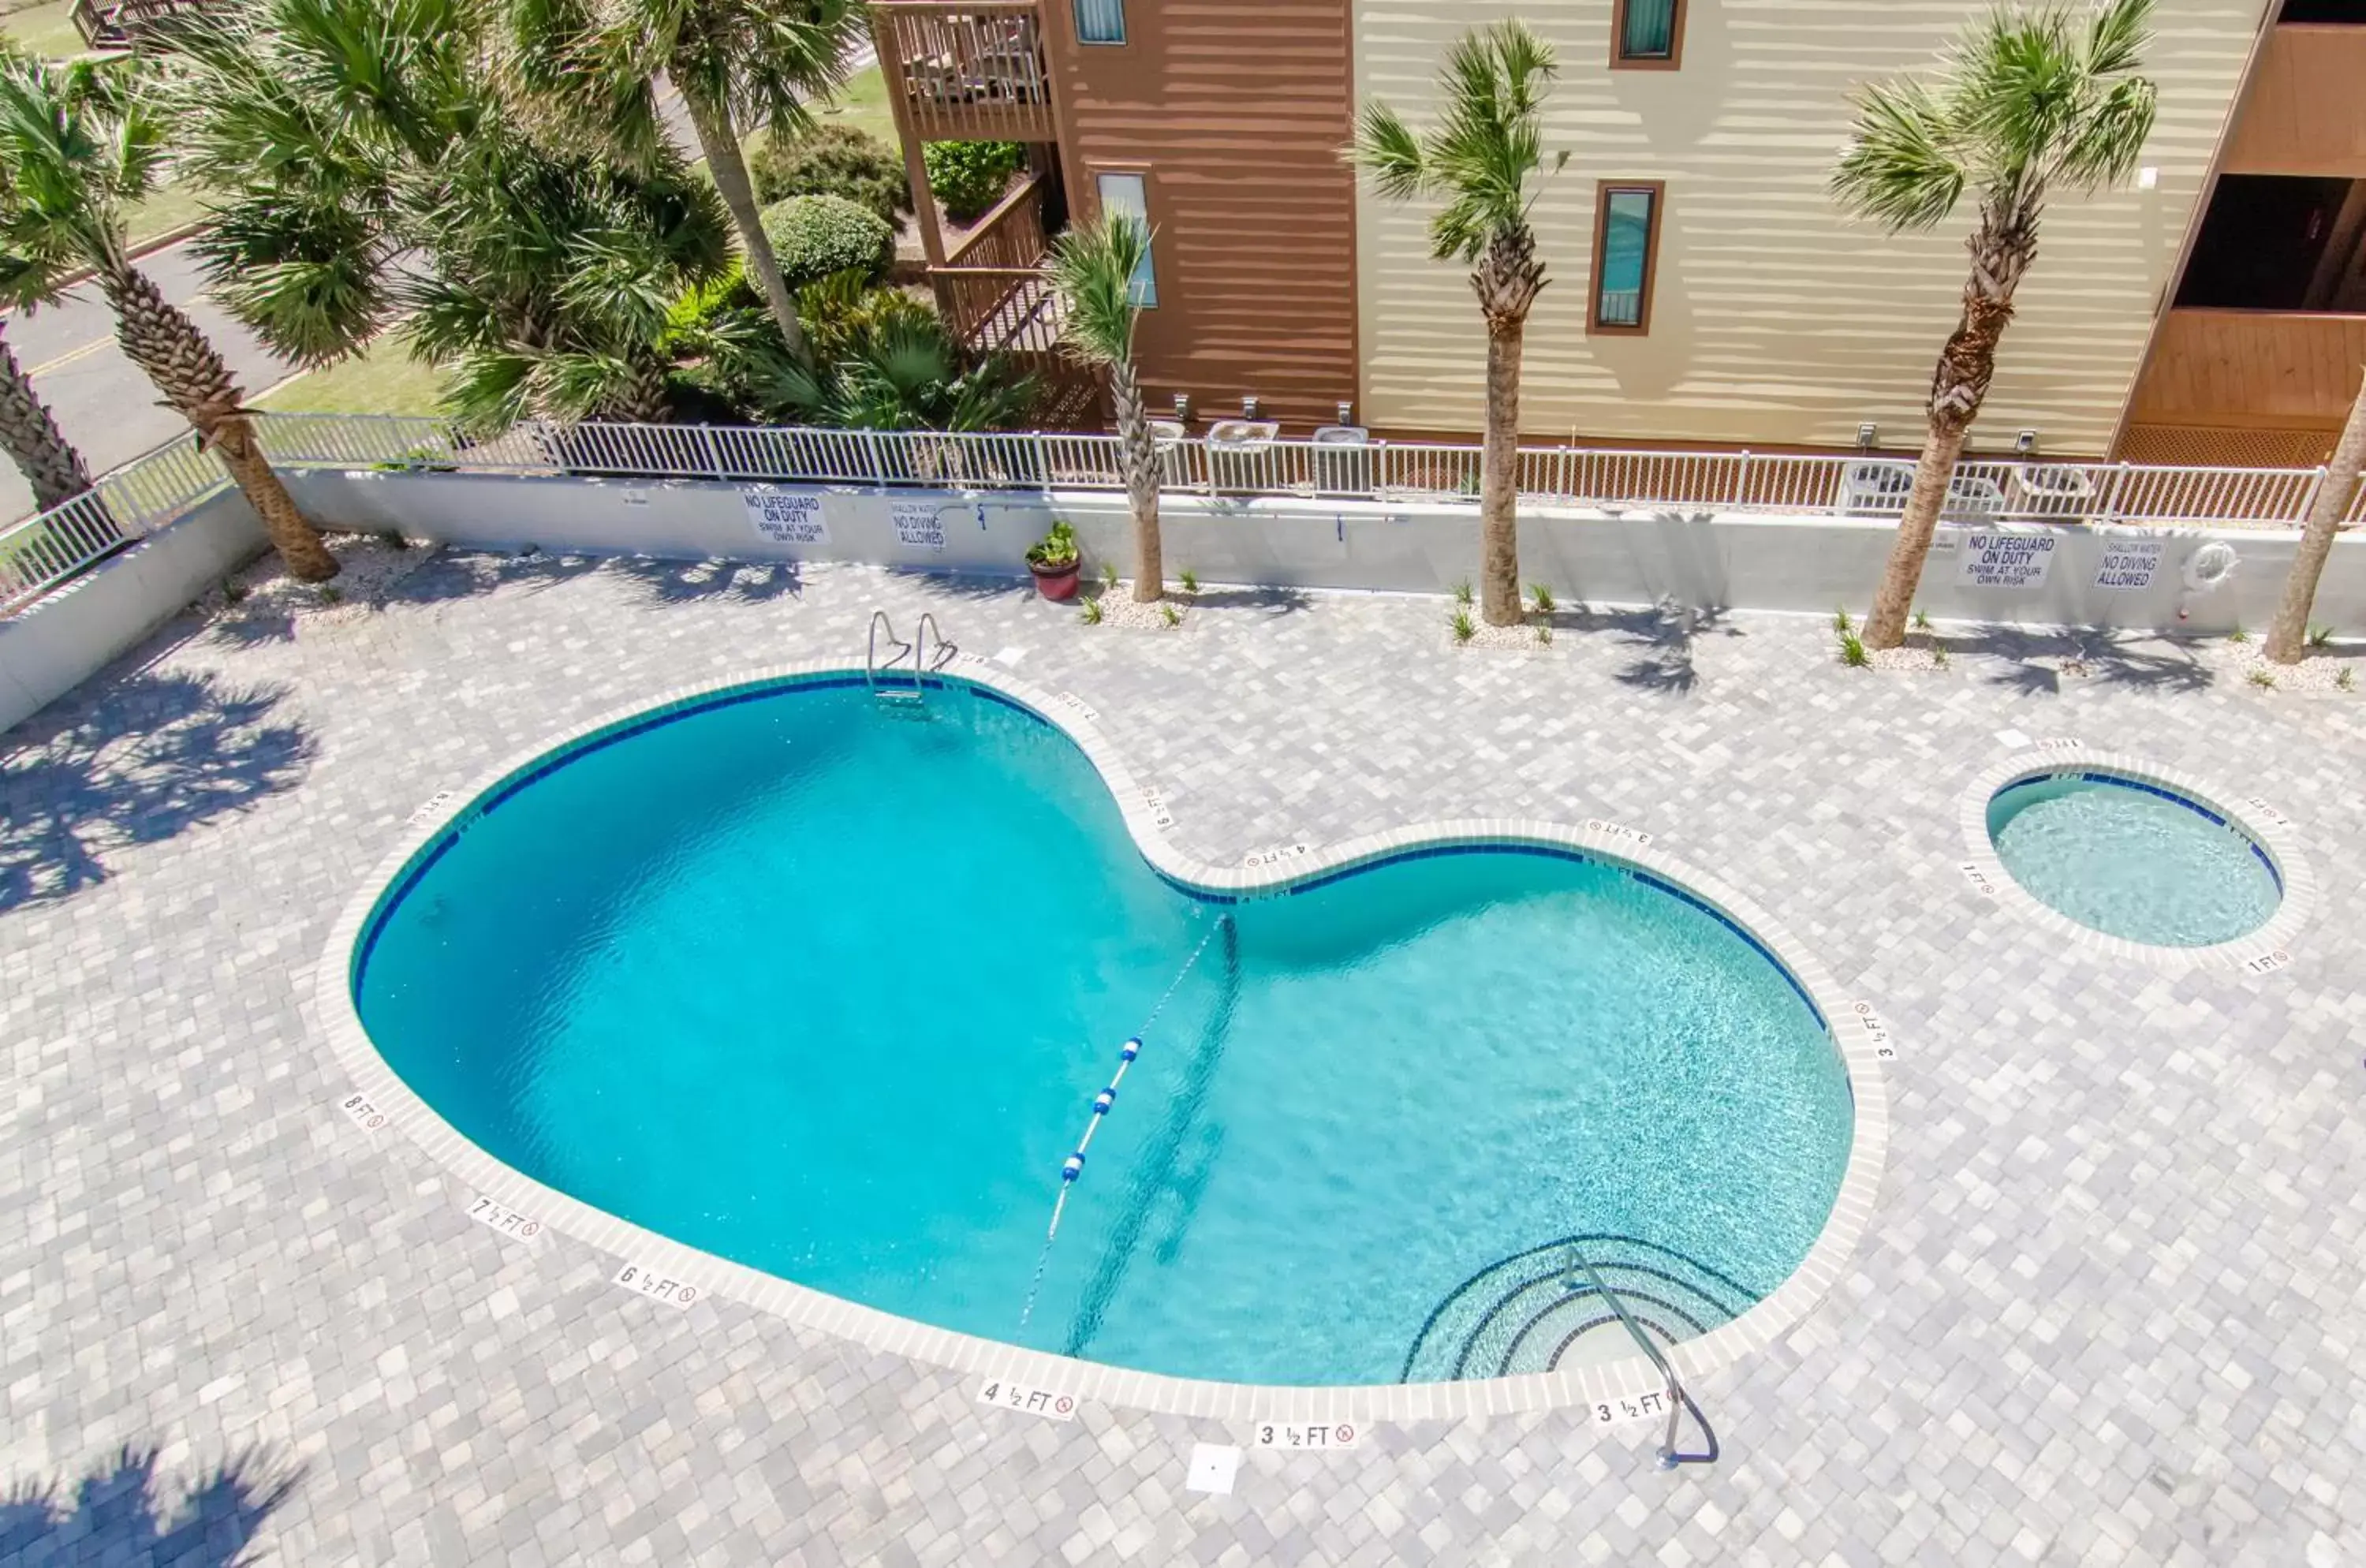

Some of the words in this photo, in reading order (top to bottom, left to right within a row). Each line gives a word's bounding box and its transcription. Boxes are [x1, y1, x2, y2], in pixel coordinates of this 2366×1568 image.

[745, 495, 760, 508] NO
[761, 495, 819, 510] LIFEGUARD
[764, 510, 779, 521] ON
[781, 510, 808, 522] DUTY
[894, 516, 909, 528] NO
[909, 517, 941, 529] DIVING
[901, 531, 944, 543] ALLOWED
[1969, 536, 1987, 550] NO
[1988, 536, 2054, 551] LIFEGUARD
[1982, 551, 1998, 564] ON
[2001, 552, 2034, 565] DUTY
[2103, 554, 2119, 569] NO
[2120, 556, 2156, 570] DIVING
[1967, 564, 1995, 574] SWIM
[1998, 566, 2010, 575] AT
[2013, 566, 2043, 577] YOUR
[1976, 575, 1999, 584] OWN
[2003, 577, 2025, 585] RISK
[2097, 572, 2149, 585] ALLOWED
[2248, 962, 2261, 972] 1
[2259, 956, 2277, 969] FT
[1862, 1017, 1880, 1029] FT
[1878, 1048, 1893, 1057] 3
[345, 1096, 362, 1108] 8
[353, 1103, 375, 1120] FT
[473, 1199, 490, 1213] 7
[499, 1215, 526, 1232] FT
[621, 1267, 637, 1282] 6
[653, 1279, 679, 1298] FT
[984, 1383, 999, 1401] 4
[1026, 1391, 1052, 1411] FT
[1598, 1404, 1612, 1422] 3
[1640, 1392, 1662, 1413] FT
[1261, 1425, 1274, 1444] 3
[1307, 1426, 1330, 1446] FT
